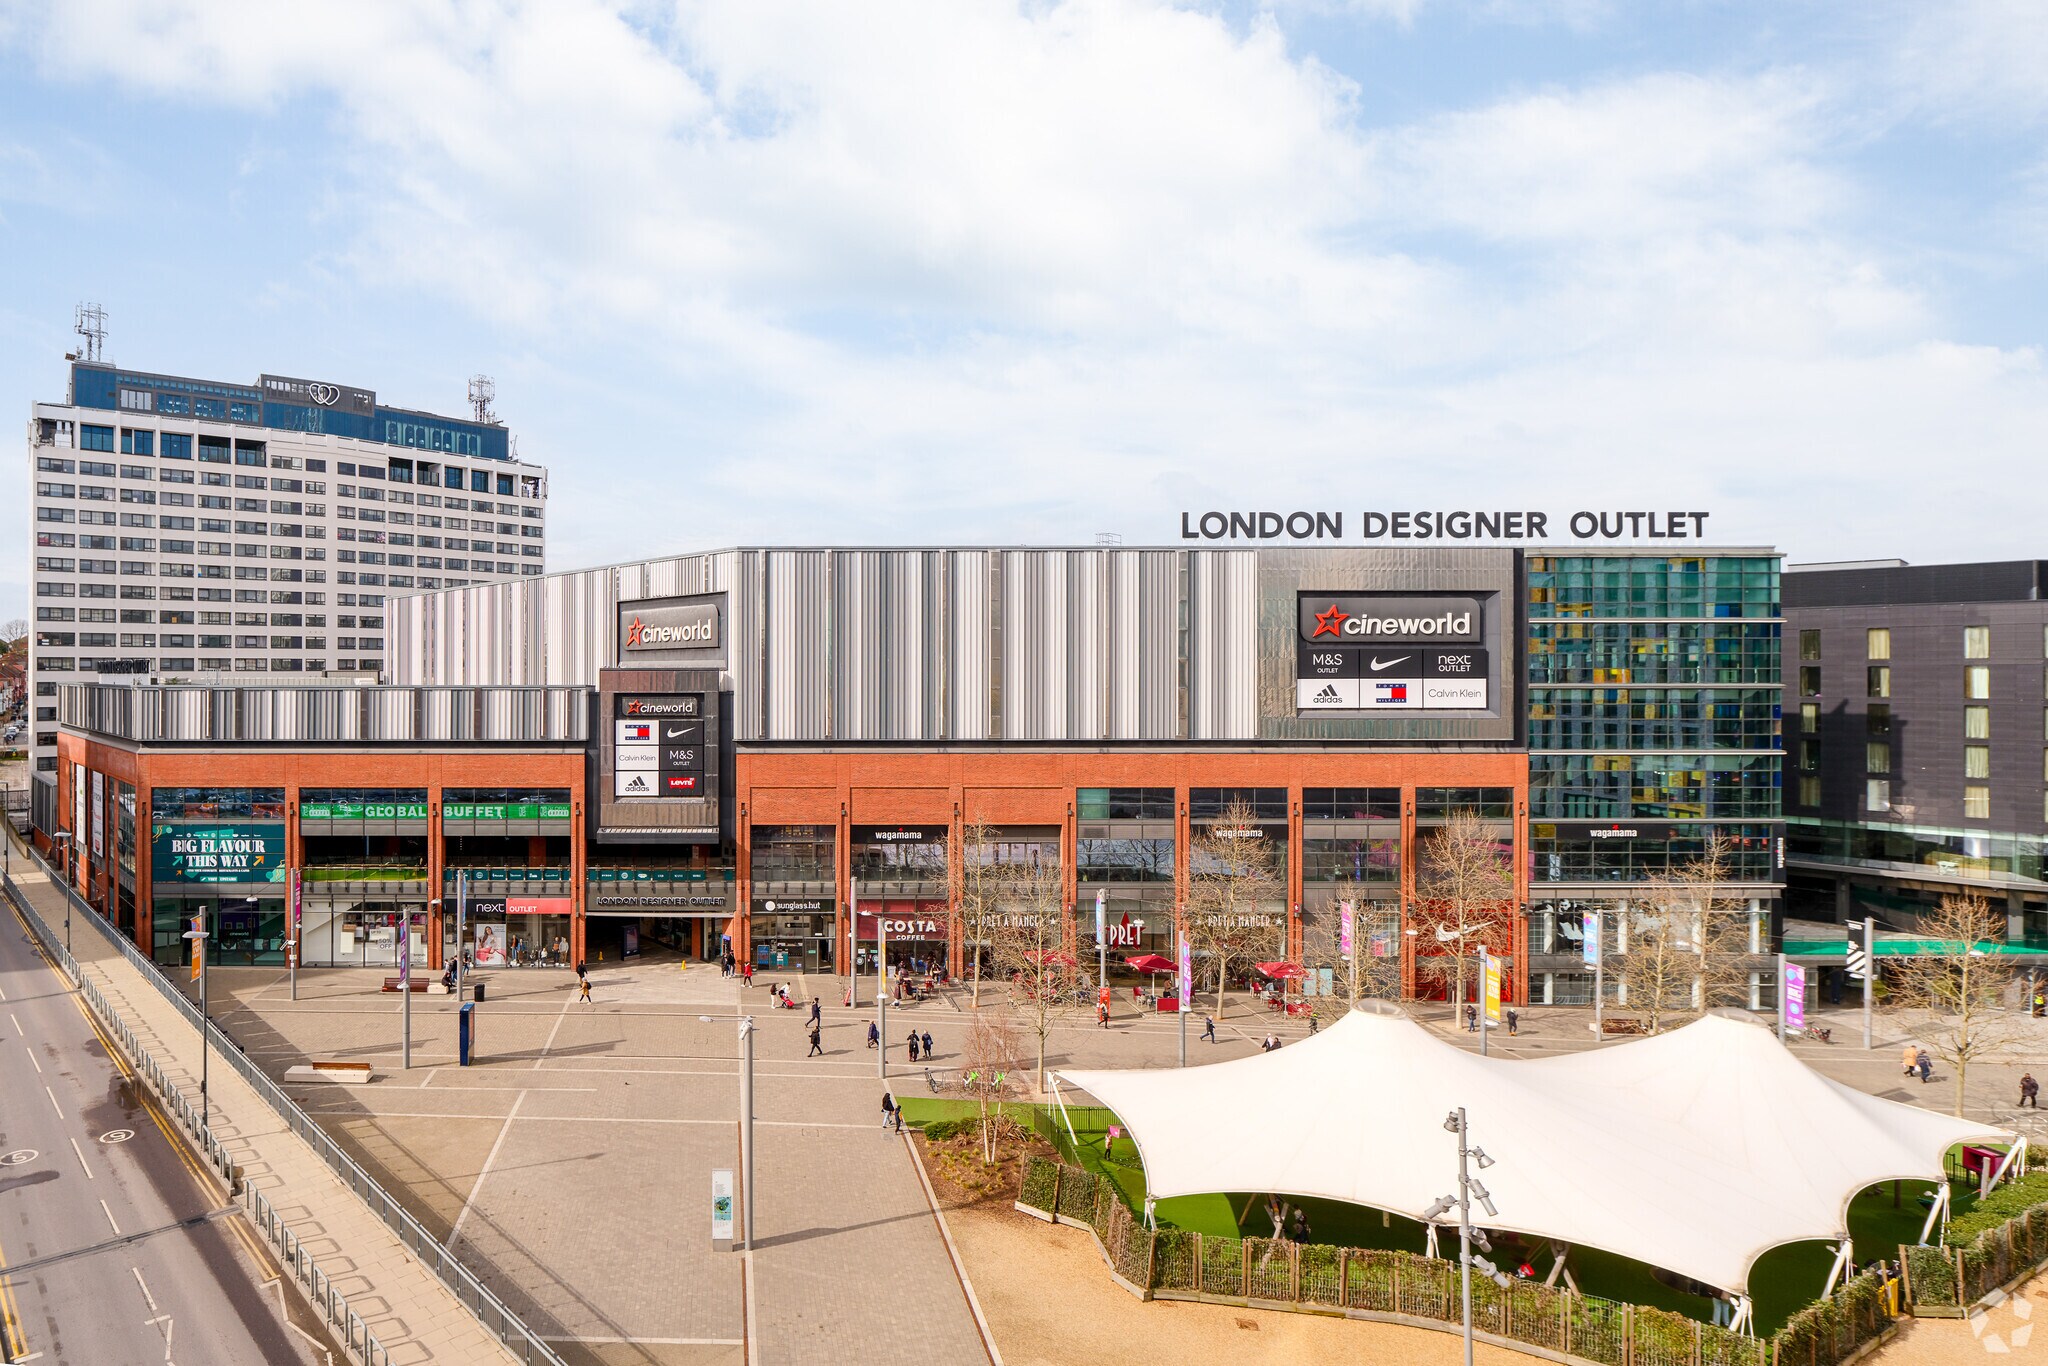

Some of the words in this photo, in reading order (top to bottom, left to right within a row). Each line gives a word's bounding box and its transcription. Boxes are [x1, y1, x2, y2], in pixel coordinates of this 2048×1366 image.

[1182, 511, 1342, 540] LONDON
[1364, 511, 1548, 539] DESIGNER
[1570, 511, 1709, 538] OUTLET
[1344, 612, 1470, 636] cineworld
[642, 618, 712, 643] cineworld
[1312, 654, 1342, 666] M&S
[1438, 654, 1472, 664] next
[1428, 689, 1458, 698] Calvin
[1460, 689, 1482, 698] Klein
[640, 703, 692, 712] cineworld
[670, 750, 694, 760] M&S
[365, 806, 426, 817] GLOBAL
[443, 806, 503, 817] BUFFET
[875, 832, 922, 840] wagamama
[1216, 830, 1262, 838] wagamama
[1590, 830, 1637, 838] wagamama
[172, 840, 197, 853] BIG
[201, 840, 265, 853] FLAVOUR
[186, 855, 217, 867] THIS
[220, 855, 249, 867] WAY
[597, 897, 638, 906] LONDON
[640, 897, 688, 906] DESIGNER
[690, 897, 726, 906] OUTLET
[777, 901, 807, 910] sunglass
[476, 904, 504, 912] next
[982, 914, 1000, 927] PRET
[1238, 915, 1270, 927] MANGER
[884, 920, 936, 933] COSTA
[1110, 924, 1141, 945] PRET
